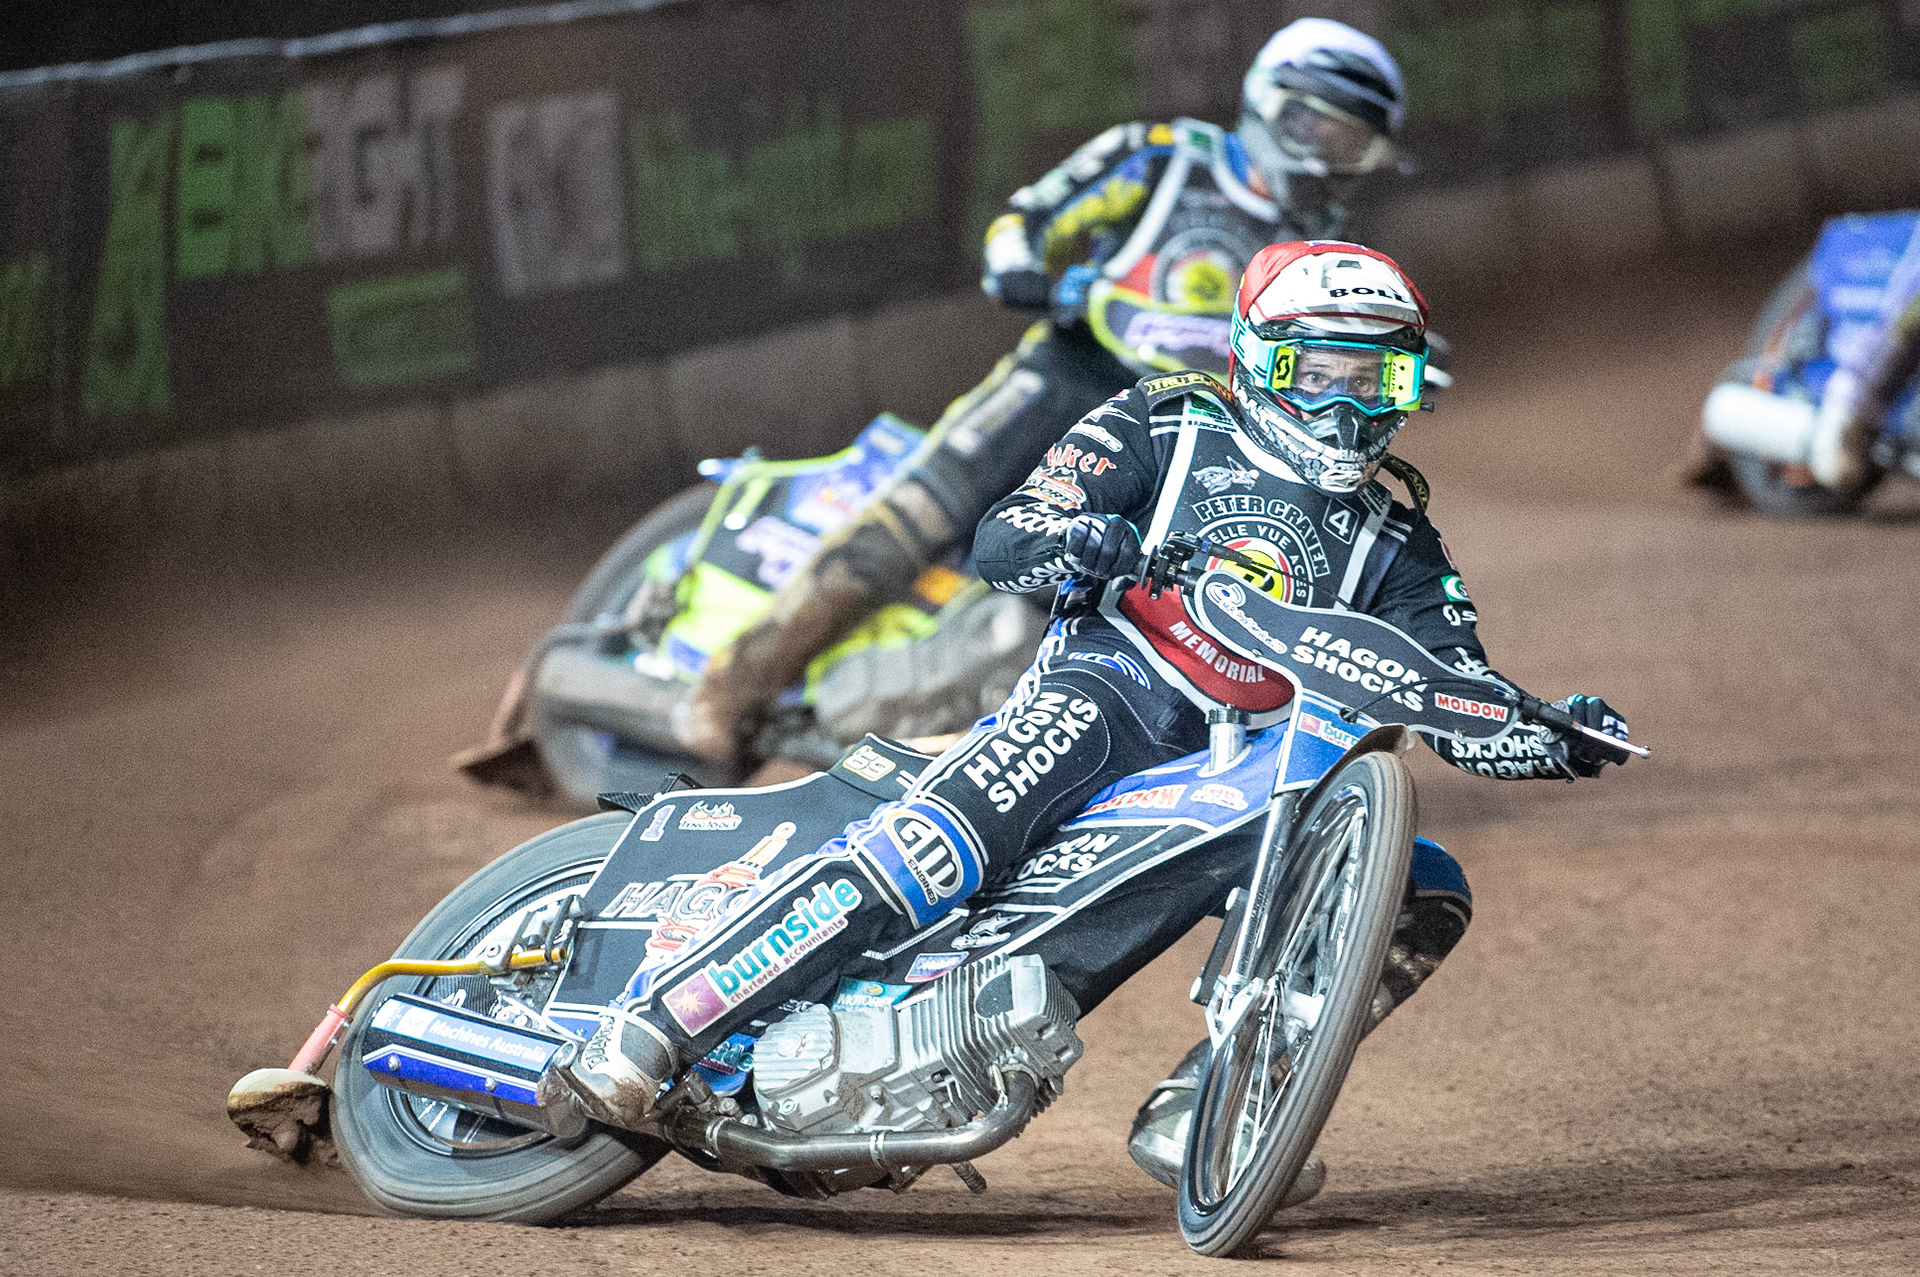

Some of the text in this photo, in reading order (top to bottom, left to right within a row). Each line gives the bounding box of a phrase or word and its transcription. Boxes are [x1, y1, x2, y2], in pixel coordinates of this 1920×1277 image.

[1193, 495, 1330, 577] PETER CRAVEN
[1329, 510, 1351, 536] 4
[1208, 524, 1306, 598] ELLE VUE ACES
[1169, 620, 1267, 683] MEMORIAL
[1291, 645, 1424, 712] SHOCKS
[1300, 627, 1429, 693] HAGON
[1437, 694, 1506, 720] MOLDOW
[963, 691, 1069, 791] HAGON
[988, 698, 1099, 813] SHOCKS
[908, 859, 938, 905] ENGINES
[709, 881, 858, 998] burnside
[730, 919, 846, 1004] chartered accountants
[430, 1019, 490, 1048] Machines
[490, 1037, 547, 1064] Australia
